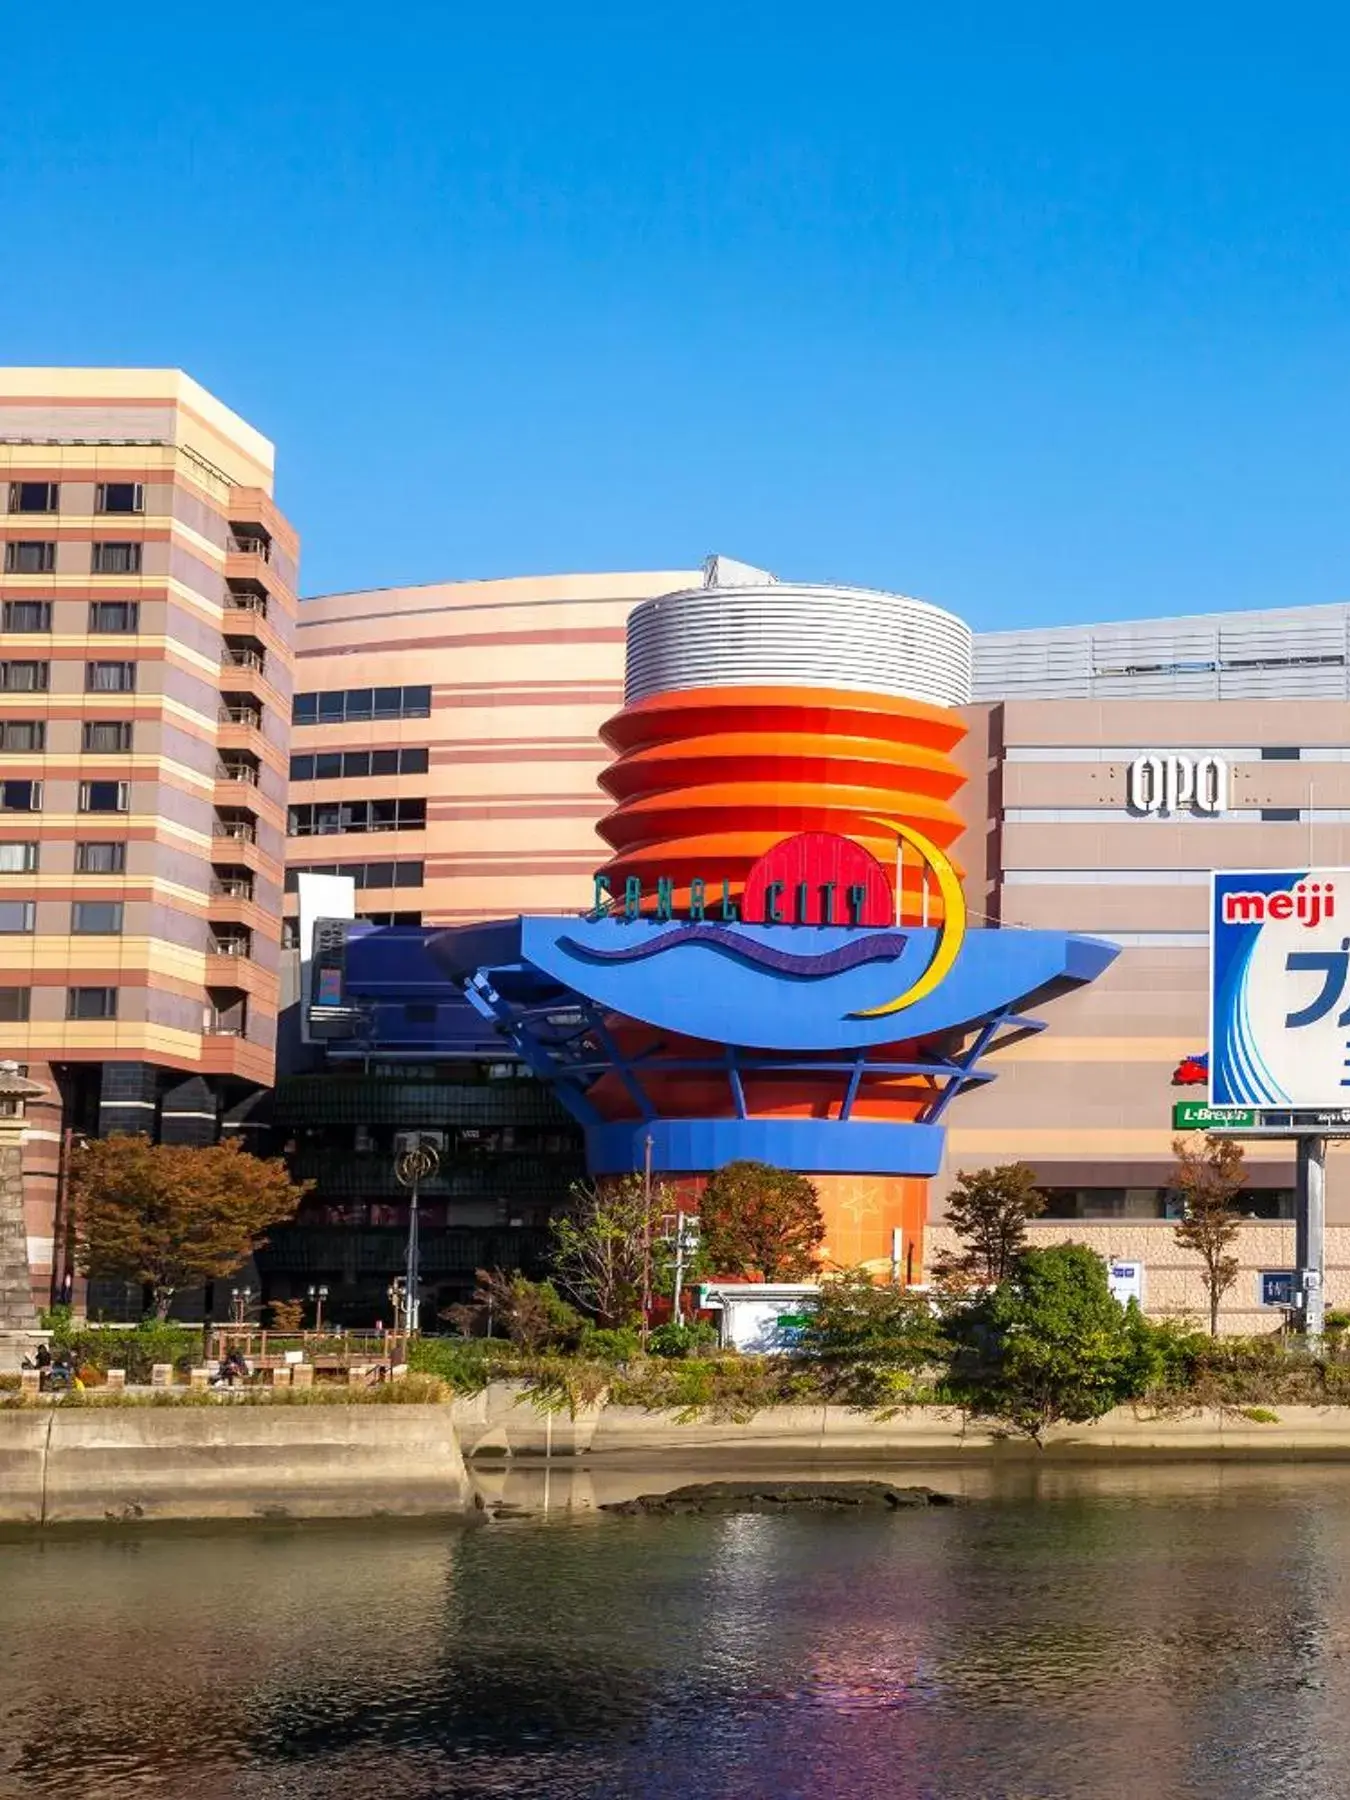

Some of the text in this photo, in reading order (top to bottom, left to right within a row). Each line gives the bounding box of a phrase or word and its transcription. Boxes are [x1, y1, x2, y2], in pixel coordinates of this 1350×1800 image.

[594, 875, 868, 924] CANAL CITY
[1226, 883, 1335, 927] meiji
